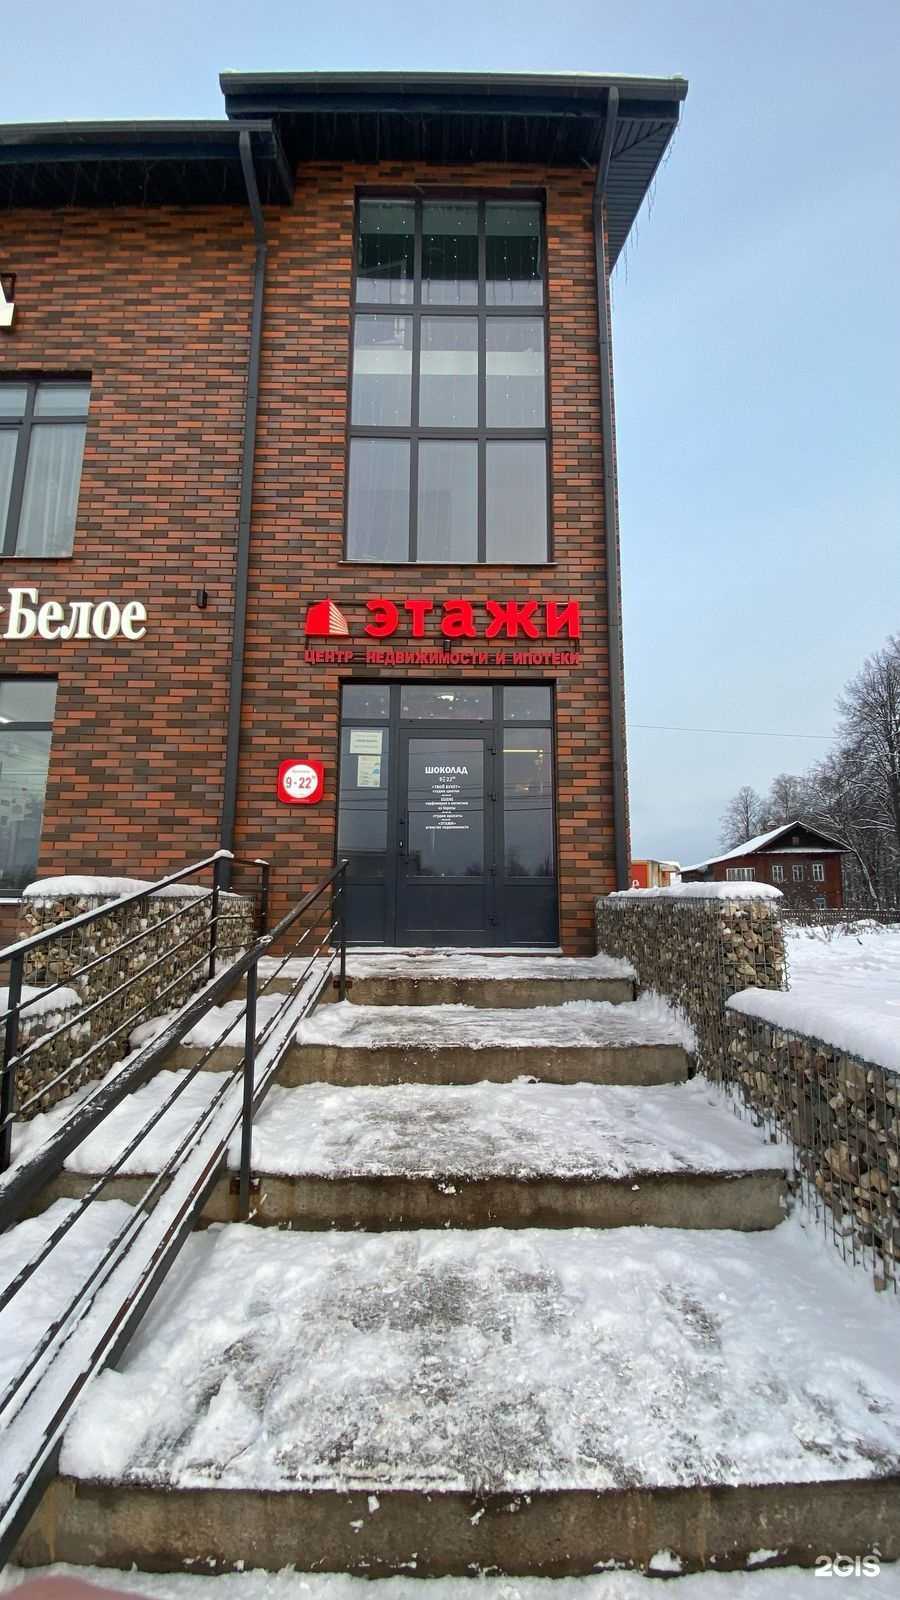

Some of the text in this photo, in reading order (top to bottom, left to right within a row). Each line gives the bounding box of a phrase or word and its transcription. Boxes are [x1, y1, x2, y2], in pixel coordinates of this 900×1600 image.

[3, 588, 147, 640] Белое
[304, 650, 580, 665] ЦЕНТР НЕДВИЖИМОСТИ И ИПОТЕКИ
[425, 766, 468, 774] ШОКОЛАД
